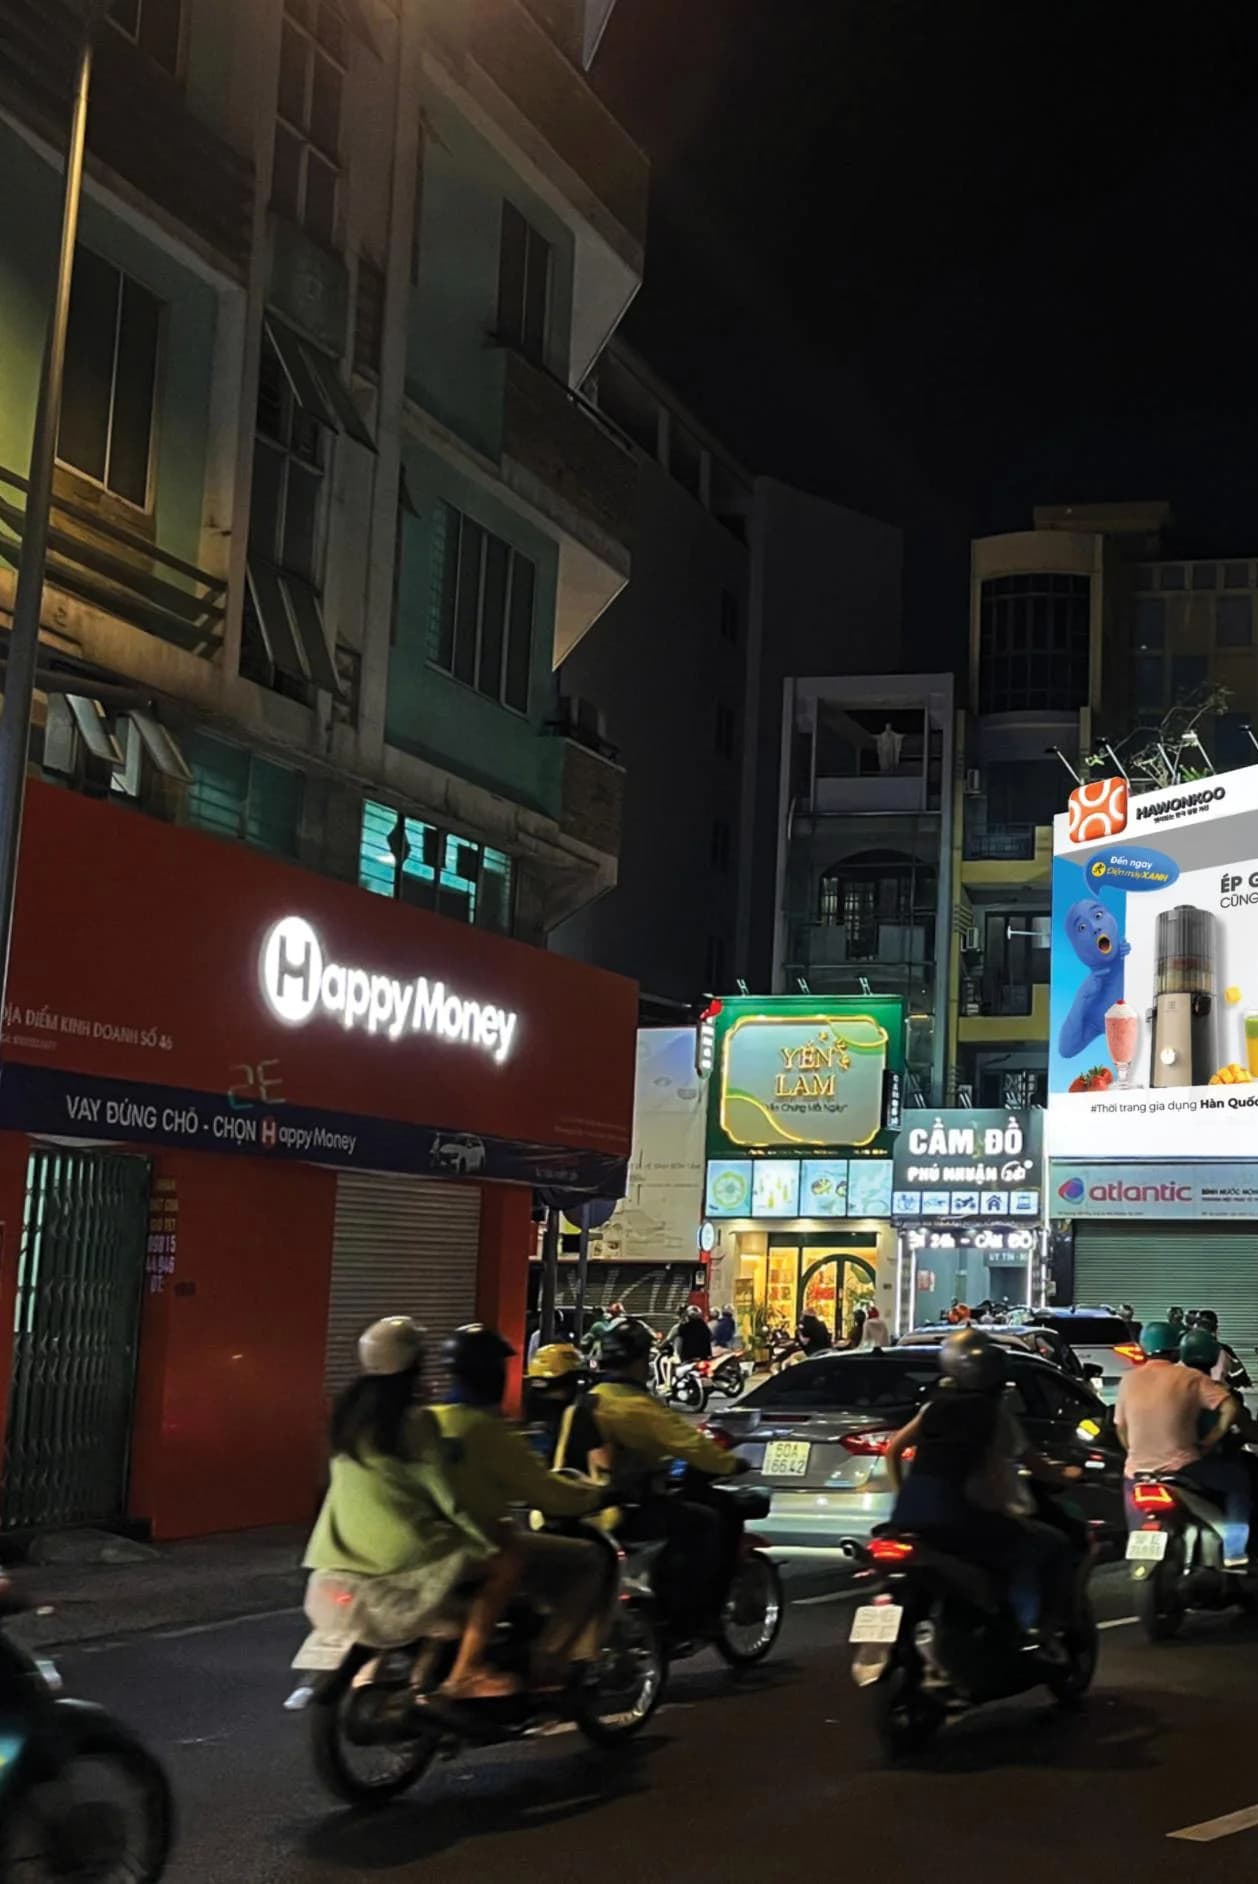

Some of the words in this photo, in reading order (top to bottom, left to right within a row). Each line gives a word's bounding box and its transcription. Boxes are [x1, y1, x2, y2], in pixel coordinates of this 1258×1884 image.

[1136, 787, 1226, 820] HAWONKOO
[1110, 856, 1128, 866] Đến
[1129, 860, 1153, 870] ngay
[1220, 873, 1242, 893] ÉP
[61, 1015, 91, 1038] KINH
[93, 1022, 139, 1045] DOANH
[1119, 1104, 1147, 1113] trang
[1148, 1102, 1165, 1113] gia
[1167, 1100, 1197, 1112] dụng
[1200, 1097, 1225, 1109] Hàn
[66, 1095, 101, 1121] VAY
[213, 1116, 256, 1145] CHỌN
[908, 1116, 974, 1155] CẦM
[984, 1116, 1023, 1155] ĐỒ
[1089, 1181, 1193, 1202] atlantic
